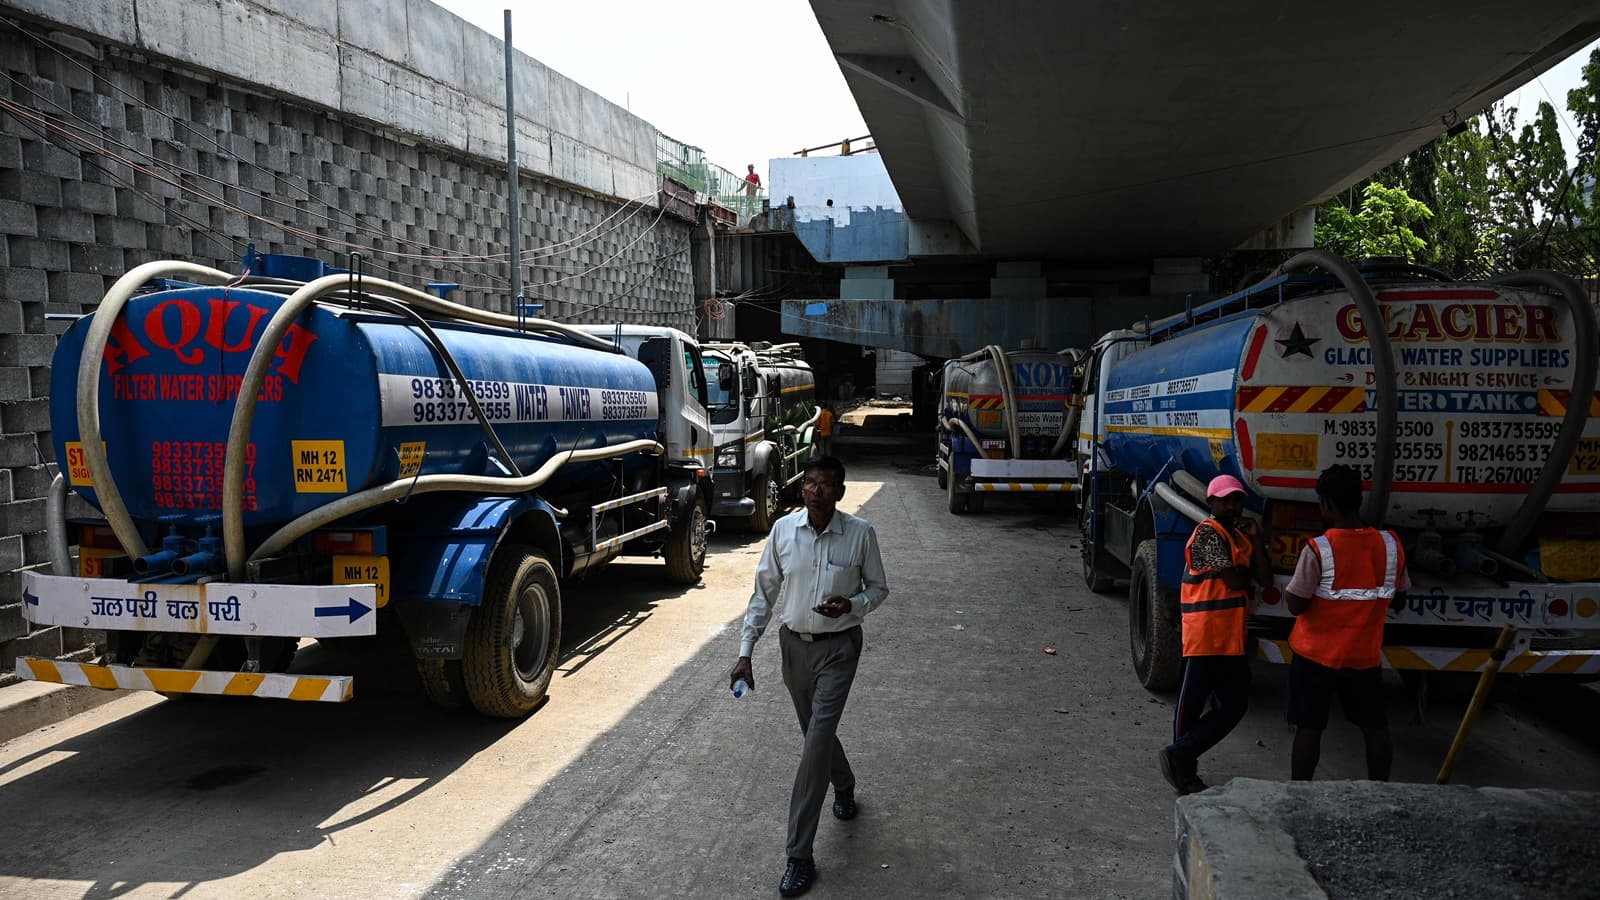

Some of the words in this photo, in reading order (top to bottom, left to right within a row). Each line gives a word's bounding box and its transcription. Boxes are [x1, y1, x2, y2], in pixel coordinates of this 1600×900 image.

[1336, 303, 1561, 343] GLACIER
[104, 299, 318, 384] AQUA
[1325, 348, 1376, 365] GLACI
[1402, 348, 1463, 366] WATER
[1470, 348, 1570, 368] SUPPLIERS
[1013, 362, 1072, 387] NOW
[1420, 372, 1470, 387] NIGHT
[1475, 372, 1538, 388] SERVICE
[114, 375, 156, 401] FILTER
[160, 375, 204, 401] WATER
[208, 375, 283, 401] SUPPRS
[514, 385, 548, 420] WATER
[560, 387, 591, 420] TANKER
[601, 390, 647, 405] 9833735500
[1365, 391, 1434, 411] WER
[1450, 392, 1521, 412] TANK
[602, 406, 648, 420] 9833735577
[1016, 413, 1040, 423] otable
[1341, 421, 1434, 437] 98335500
[1460, 421, 1562, 439] 9833735599
[69, 448, 84, 466] ST
[152, 441, 257, 459] 98337350
[301, 450, 319, 465] MH
[322, 450, 337, 464] 12
[1336, 442, 1442, 459] 98335555
[1458, 444, 1552, 462] 982146533
[73, 468, 90, 478] SIG
[152, 457, 257, 475] 98337357
[152, 475, 257, 494] 98337359
[297, 469, 314, 483] RN
[317, 468, 344, 483] 2471
[154, 491, 259, 512] 98337355
[344, 566, 362, 580] MH
[366, 566, 379, 580] 12
[167, 600, 199, 620] चल
[209, 596, 241, 622] परी
[1453, 596, 1496, 622] चल
[1498, 590, 1536, 623] परी
